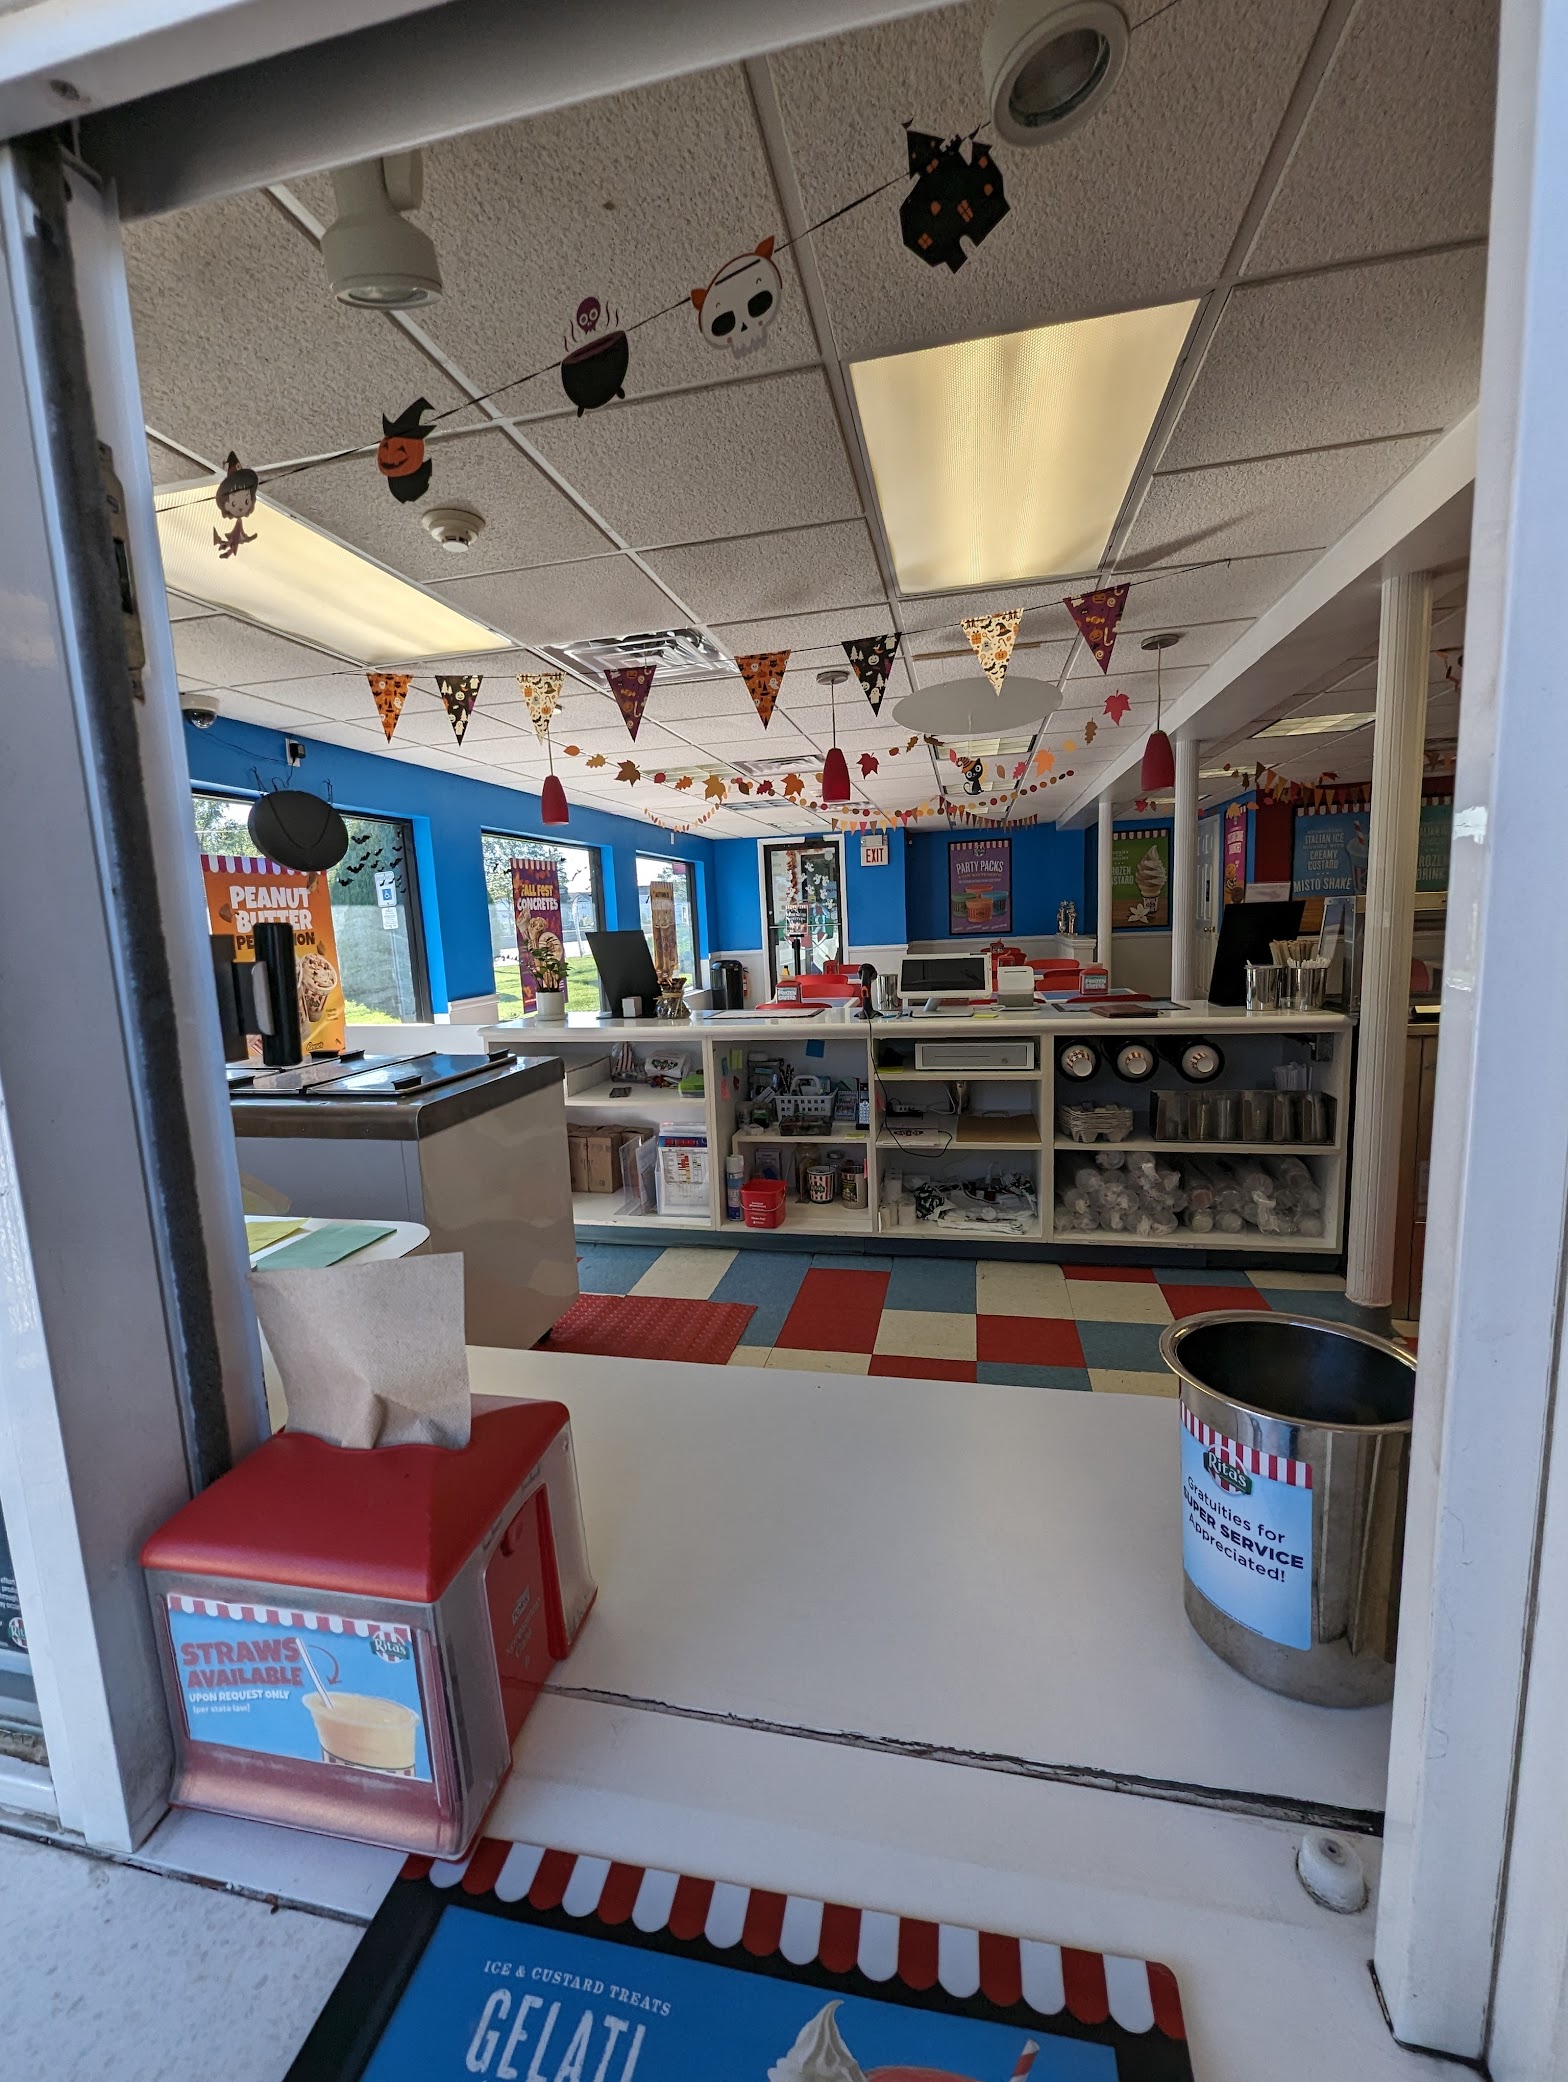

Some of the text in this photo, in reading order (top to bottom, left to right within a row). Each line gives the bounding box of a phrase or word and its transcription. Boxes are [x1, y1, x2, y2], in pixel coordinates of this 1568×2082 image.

[1305, 832, 1345, 845] ITALIAN ICE
[865, 848, 884, 863] EXIT
[1310, 849, 1339, 860] CREAMY
[956, 860, 1004, 875] PARTY PACKS
[1112, 865, 1131, 876] ROZEN
[1307, 859, 1339, 870] CUSTARD
[1113, 875, 1134, 886] STARD
[1293, 877, 1352, 893] MISTO SHAKE
[229, 885, 311, 909] PEANUT
[521, 884, 537, 897] FALL
[517, 897, 559, 911] CONCRETES
[1208, 1451, 1247, 1487] Rita's
[1187, 1475, 1286, 1544] Gratuities for
[1183, 1484, 1304, 1570] SUPER SERVICE
[1188, 1512, 1286, 1583] Appreciated!
[180, 1636, 301, 1667] STRAWS
[374, 1637, 408, 1656] Rita's
[187, 1665, 304, 1689] AVAILABLE
[188, 1689, 290, 1704] UPON REQUEST ONLY
[192, 1704, 251, 1715] (per state law)
[483, 1960, 672, 2017] ICE & CUSTARD TREATS
[465, 1988, 647, 2082] GELATI
